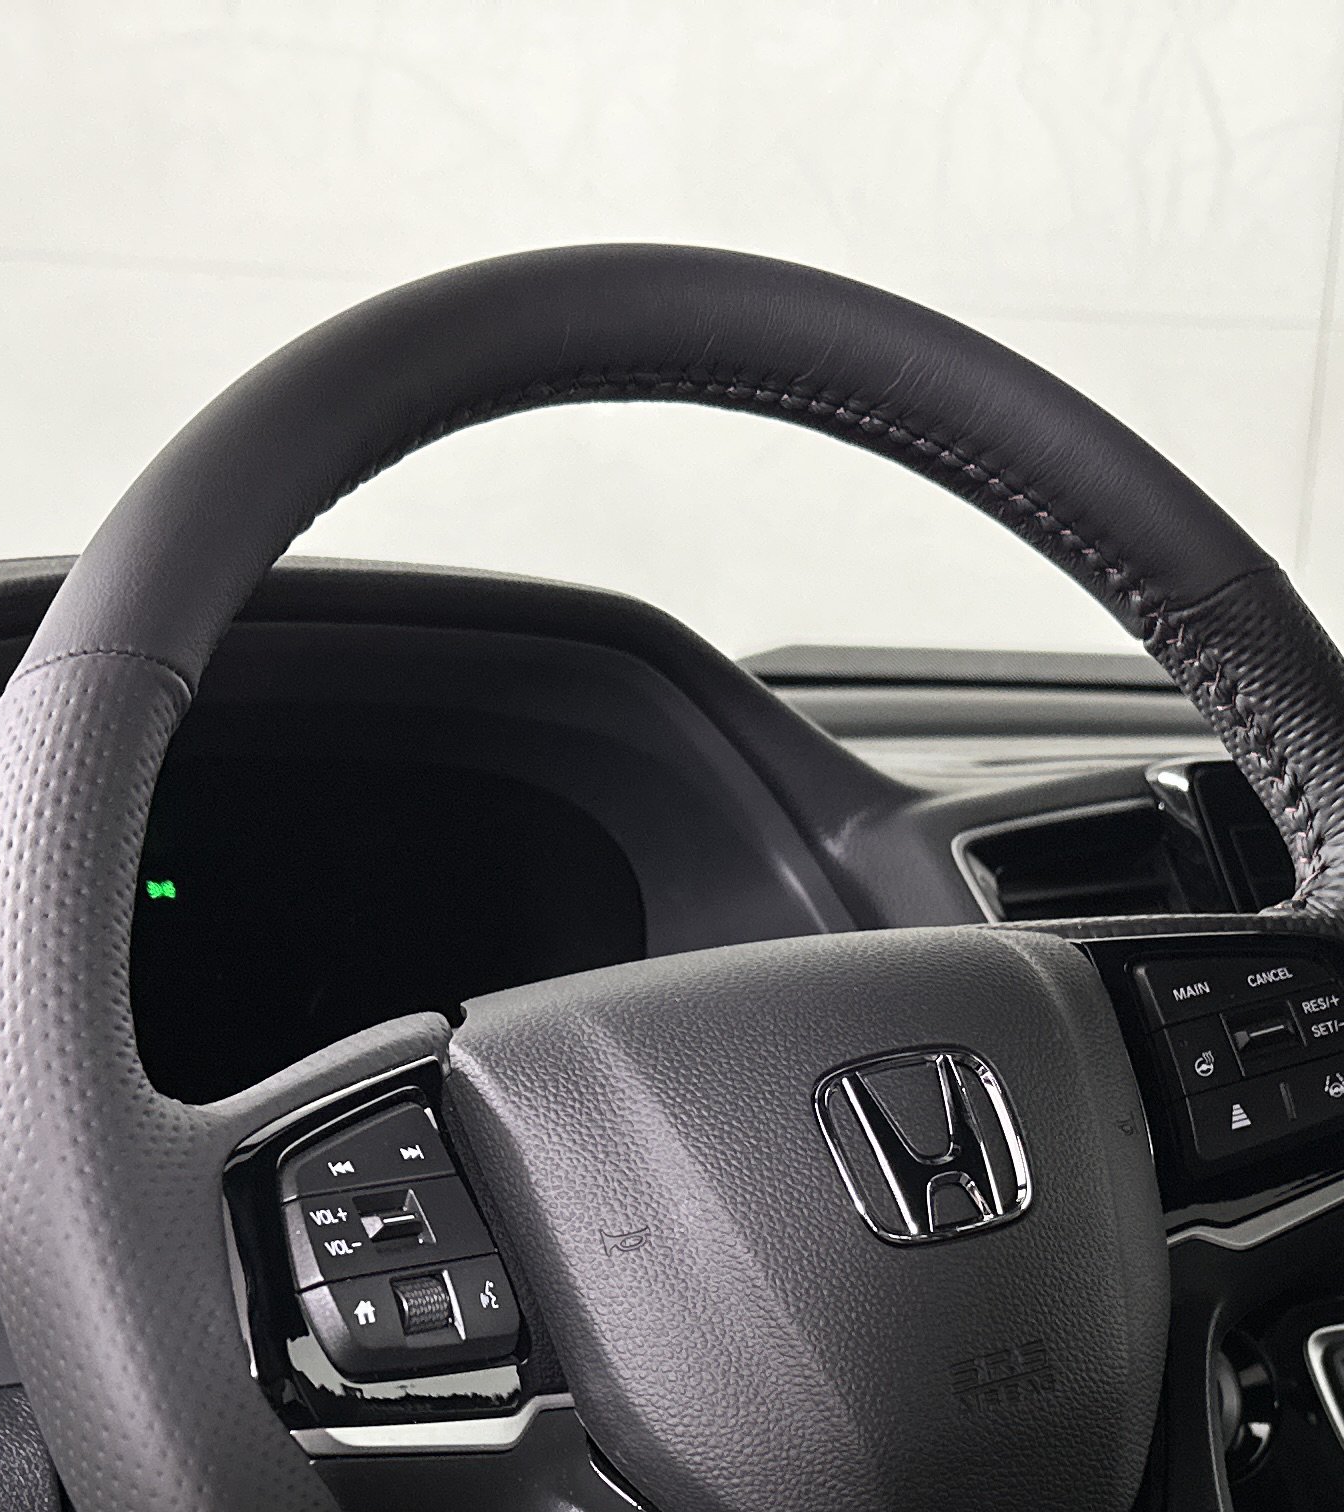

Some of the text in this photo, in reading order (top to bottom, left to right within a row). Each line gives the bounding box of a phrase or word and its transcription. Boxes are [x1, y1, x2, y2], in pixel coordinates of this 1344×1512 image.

[1247, 966, 1294, 988] CANCEL
[1172, 981, 1211, 1001] MAIN
[1301, 994, 1341, 1015] RES/+
[309, 1207, 348, 1227] VOL+
[323, 1239, 363, 1257] VOL-
